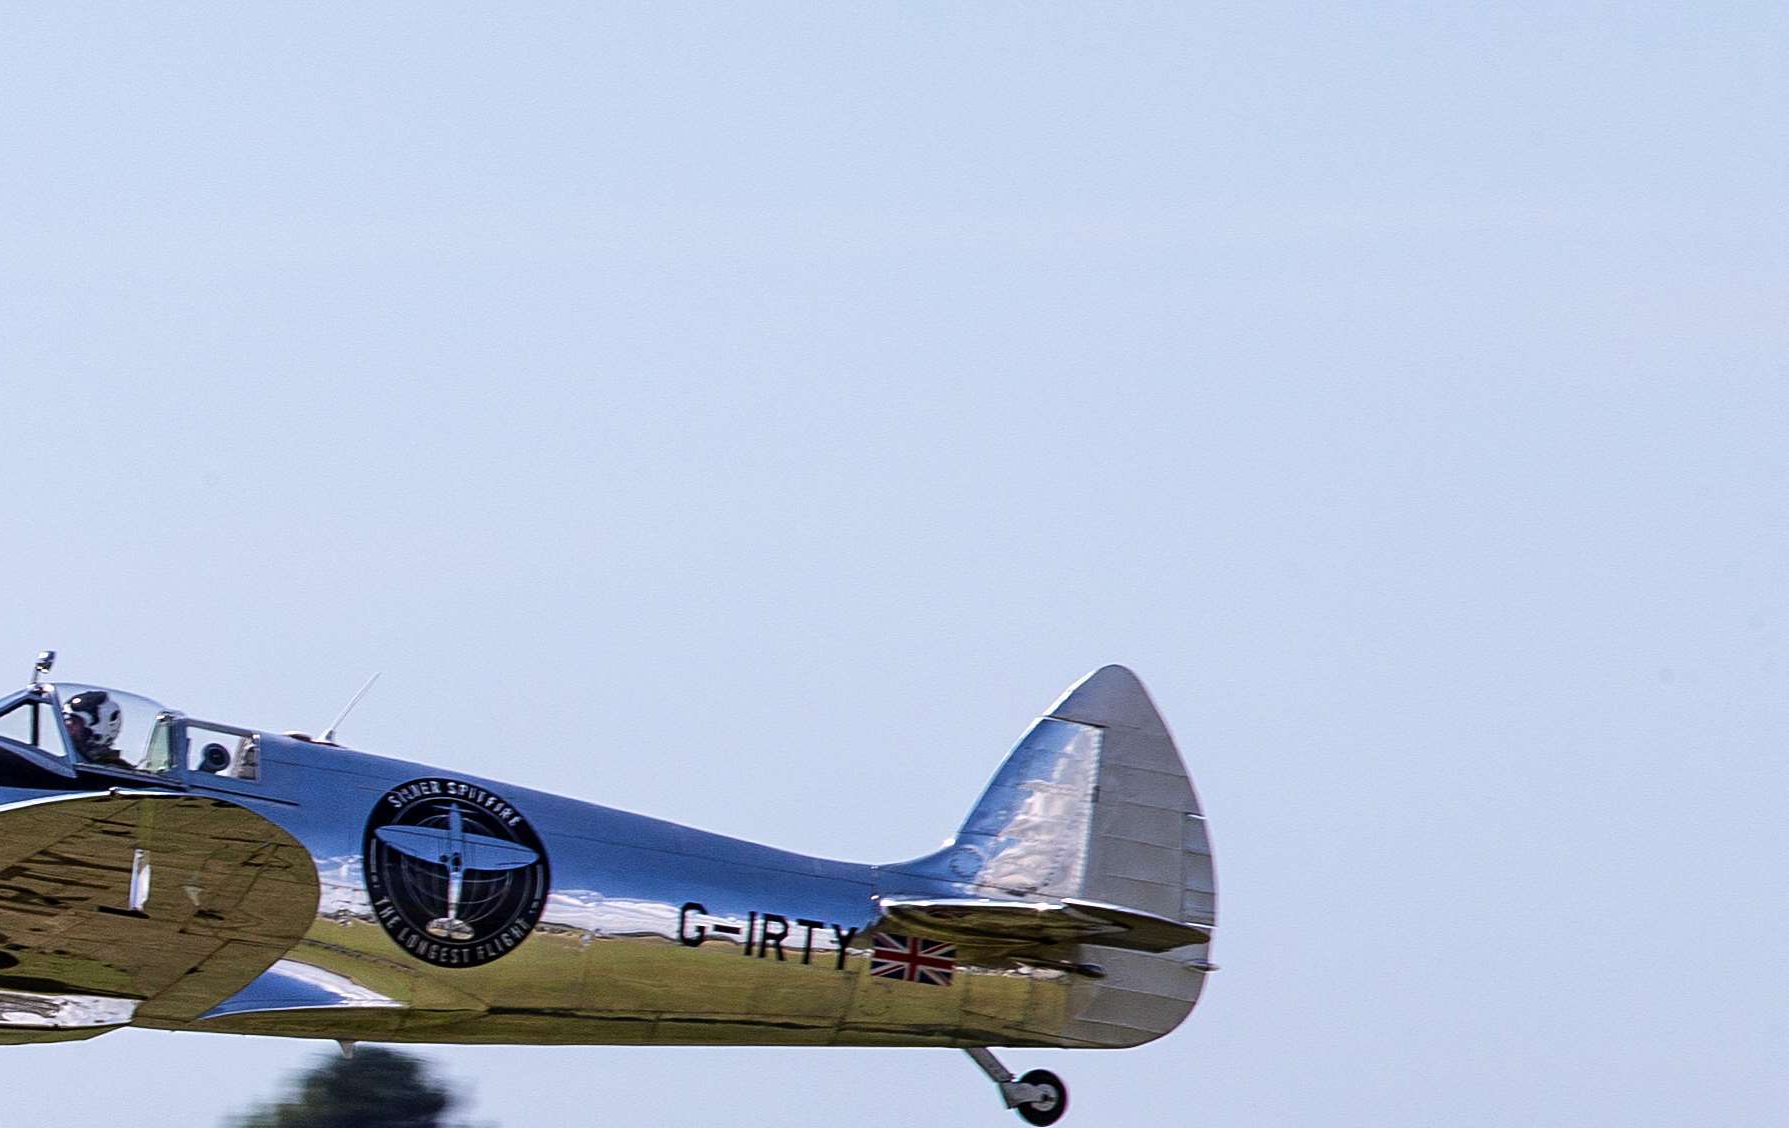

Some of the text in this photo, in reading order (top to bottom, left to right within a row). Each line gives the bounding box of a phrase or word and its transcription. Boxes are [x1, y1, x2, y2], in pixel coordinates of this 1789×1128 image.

[446, 781, 523, 827] SPITFIRE
[374, 896, 531, 964] THE LONGEST FLIGHT
[679, 901, 859, 970] G-IRTY
